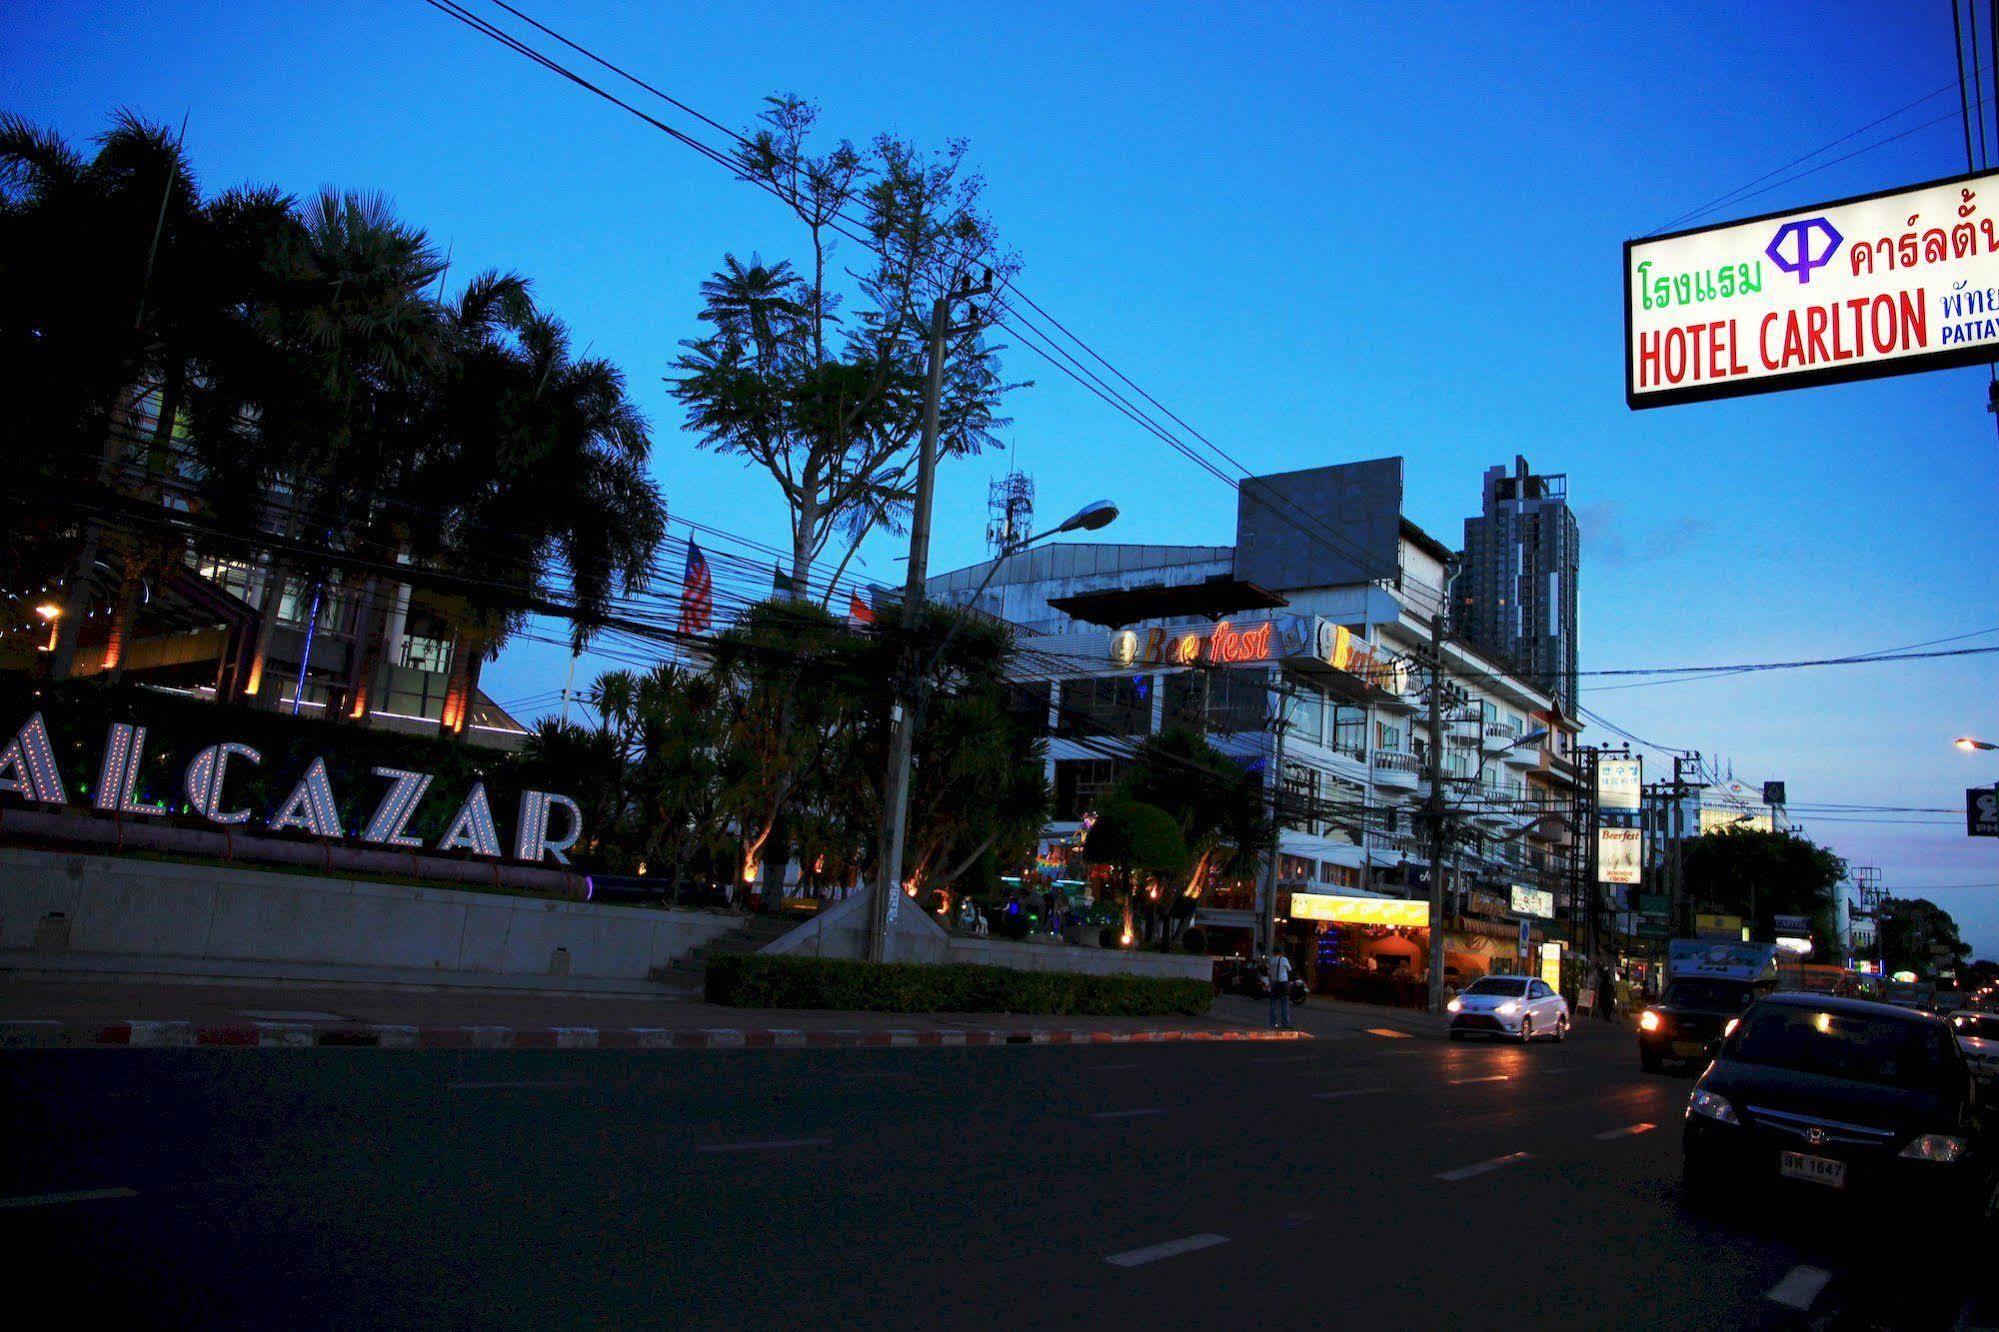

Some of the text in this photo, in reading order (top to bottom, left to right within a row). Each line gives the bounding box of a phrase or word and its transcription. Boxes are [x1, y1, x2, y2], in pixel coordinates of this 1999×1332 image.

[1638, 260, 1762, 311] โรงแรม
[1640, 288, 1927, 387] HOTEL CARLTON
[0, 711, 582, 864] ALCAZAR
[1602, 831, 1639, 842] Beerfest
